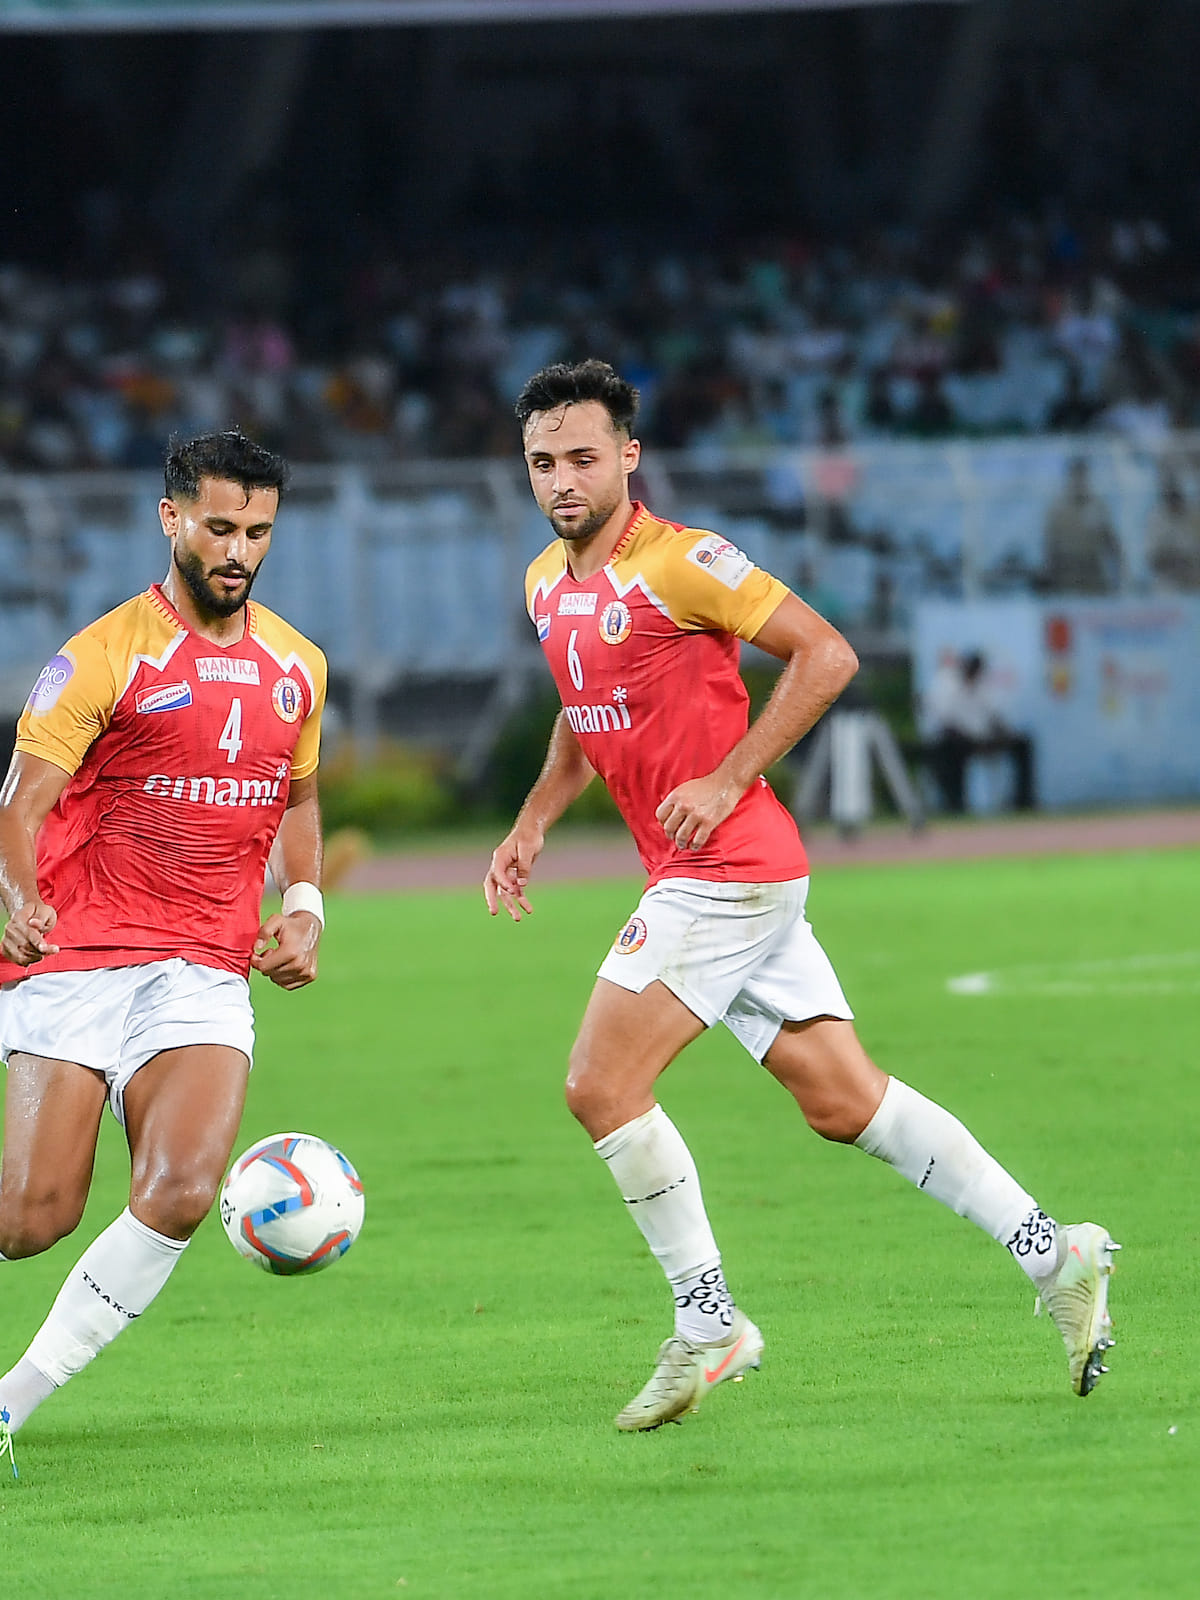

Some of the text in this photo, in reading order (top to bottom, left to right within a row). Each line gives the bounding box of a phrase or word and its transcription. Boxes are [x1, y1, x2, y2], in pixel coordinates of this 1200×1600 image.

[197, 659, 258, 677] MANTRA
[567, 630, 583, 692] 6
[218, 697, 243, 763] 4
